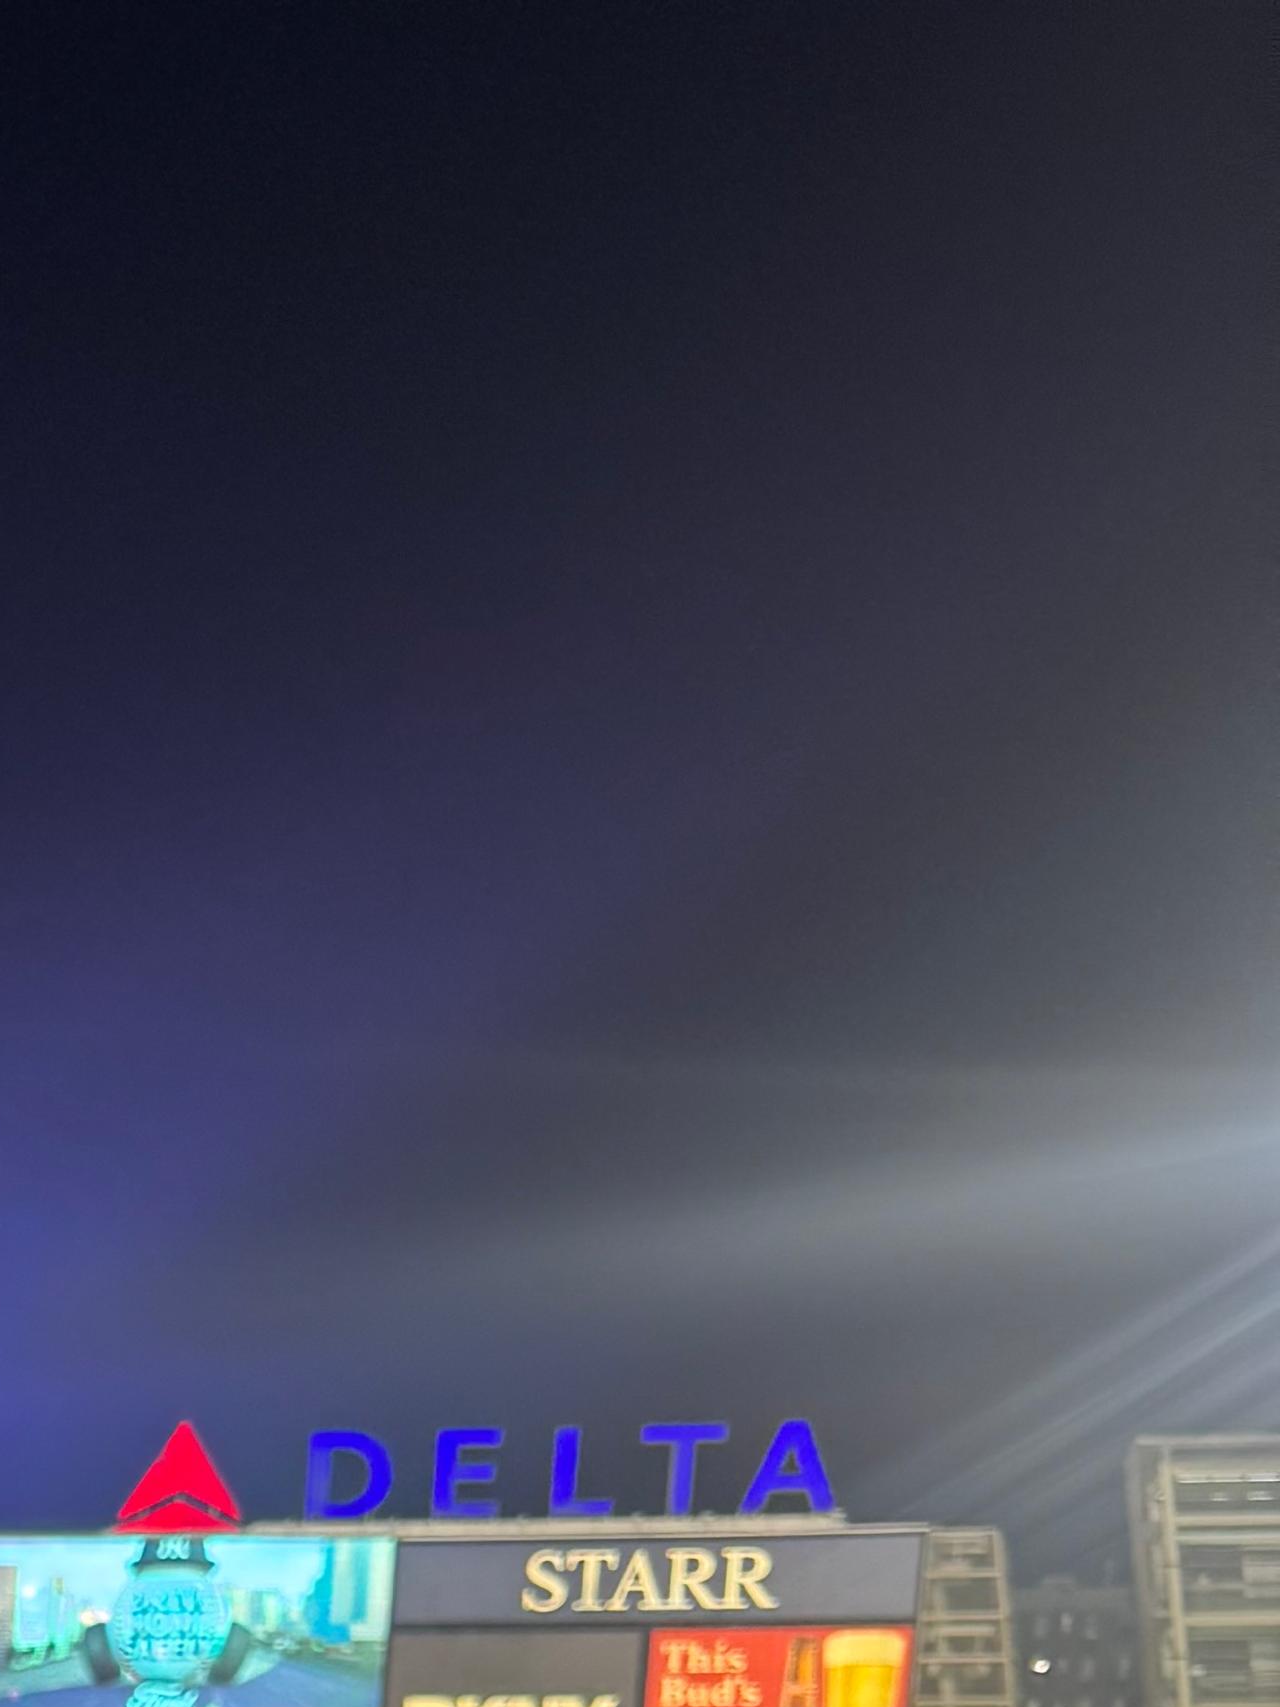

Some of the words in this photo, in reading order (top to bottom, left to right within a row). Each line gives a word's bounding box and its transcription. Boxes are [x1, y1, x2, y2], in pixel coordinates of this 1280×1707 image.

[304, 1418, 837, 1519] DELTA
[521, 1546, 780, 1613] STARR
[659, 1638, 749, 1675] This
[659, 1675, 763, 1707] Bud's
